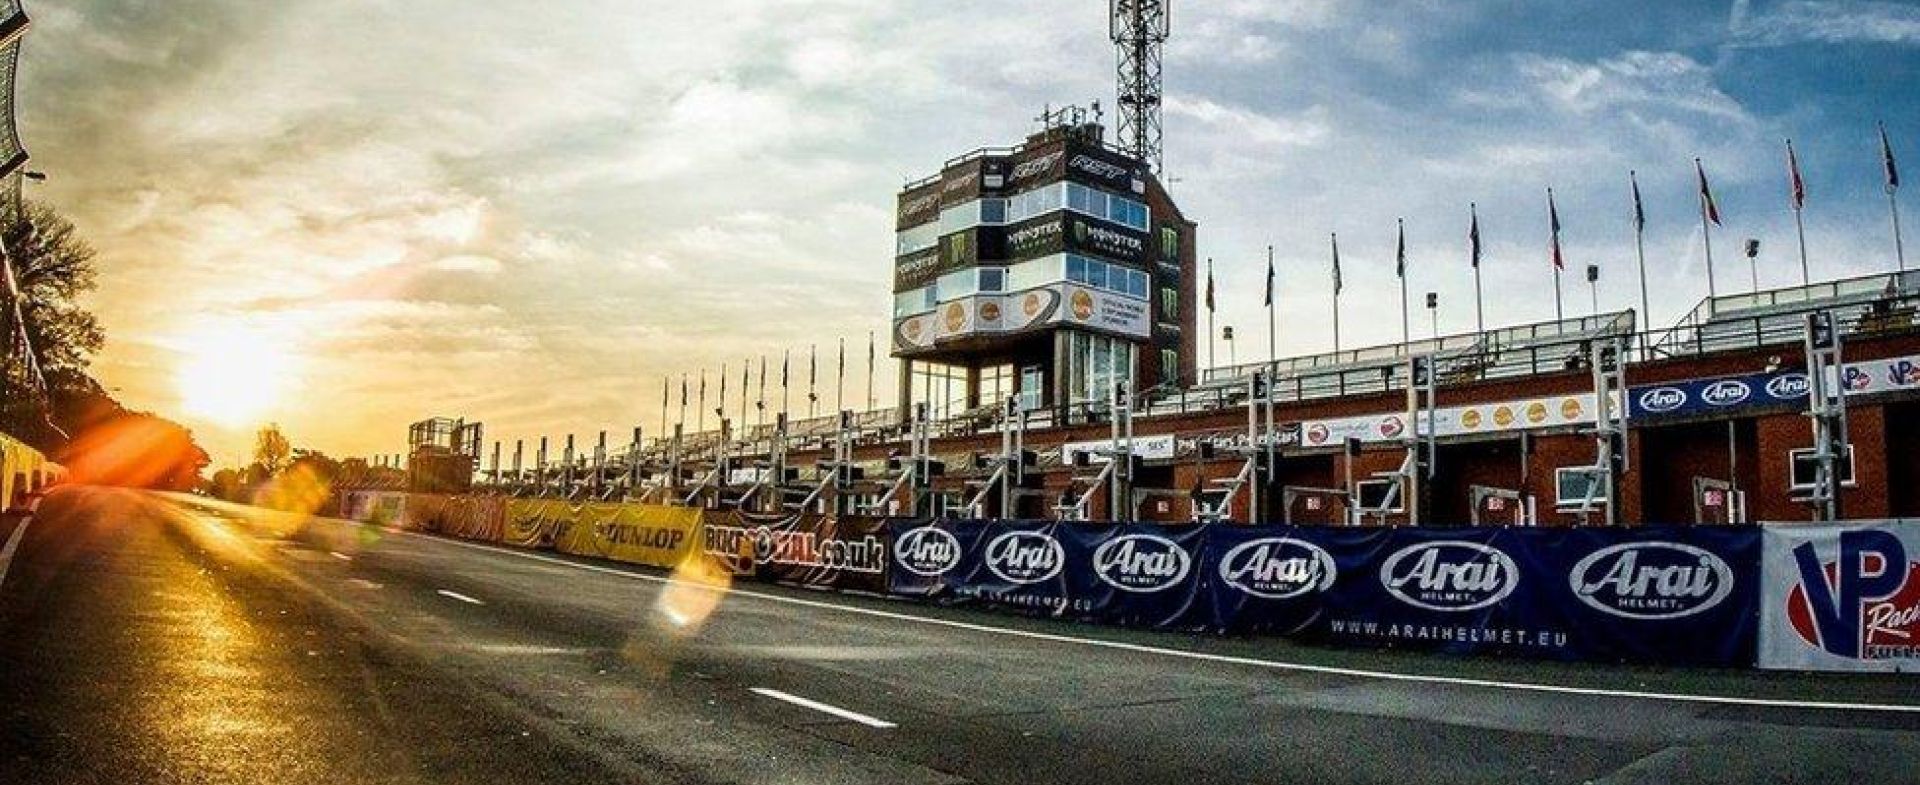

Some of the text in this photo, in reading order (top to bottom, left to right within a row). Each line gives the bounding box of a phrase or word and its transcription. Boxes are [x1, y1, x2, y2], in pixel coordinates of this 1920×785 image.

[1708, 383, 1743, 397] Arai
[1841, 367, 1859, 389] P
[1648, 391, 1679, 404] Arai
[602, 522, 684, 549] DUNLOP
[900, 531, 951, 563] Arai
[991, 536, 1055, 569] Arai
[1099, 539, 1178, 577] Arai
[1229, 544, 1322, 583] Arai
[1388, 548, 1501, 591] Arai
[1579, 550, 1713, 596] Arai
[1421, 592, 1470, 601] HELMET
[1618, 599, 1677, 608] HELMET
[1793, 529, 1907, 659] VP
[1331, 620, 1567, 647] WWW.ARAIHELMET.EU
